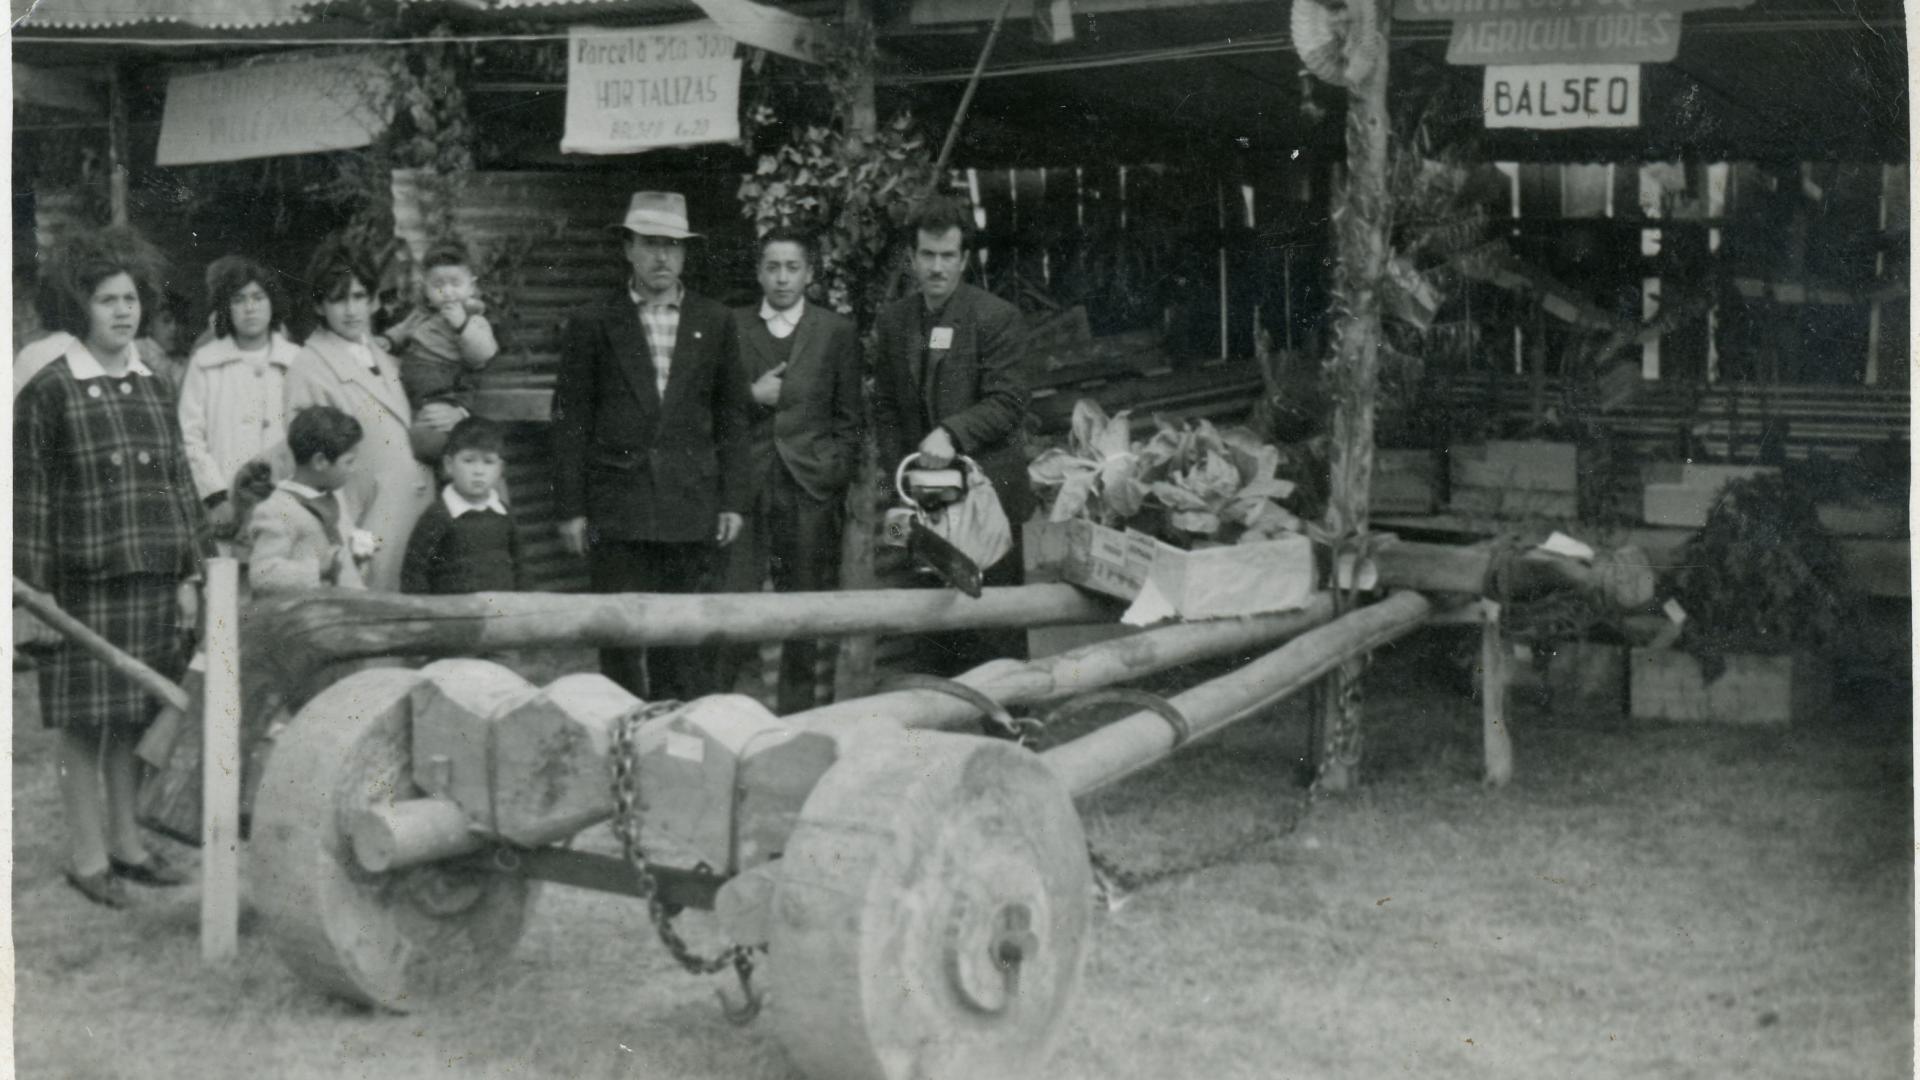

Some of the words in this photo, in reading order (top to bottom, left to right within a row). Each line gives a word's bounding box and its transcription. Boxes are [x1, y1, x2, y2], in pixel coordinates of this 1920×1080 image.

[1456, 12, 1674, 51] AGRICULTORES
[577, 37, 646, 65] Parcela
[596, 74, 717, 109] HORTALIZAS
[1494, 77, 1628, 116] BALSEO
